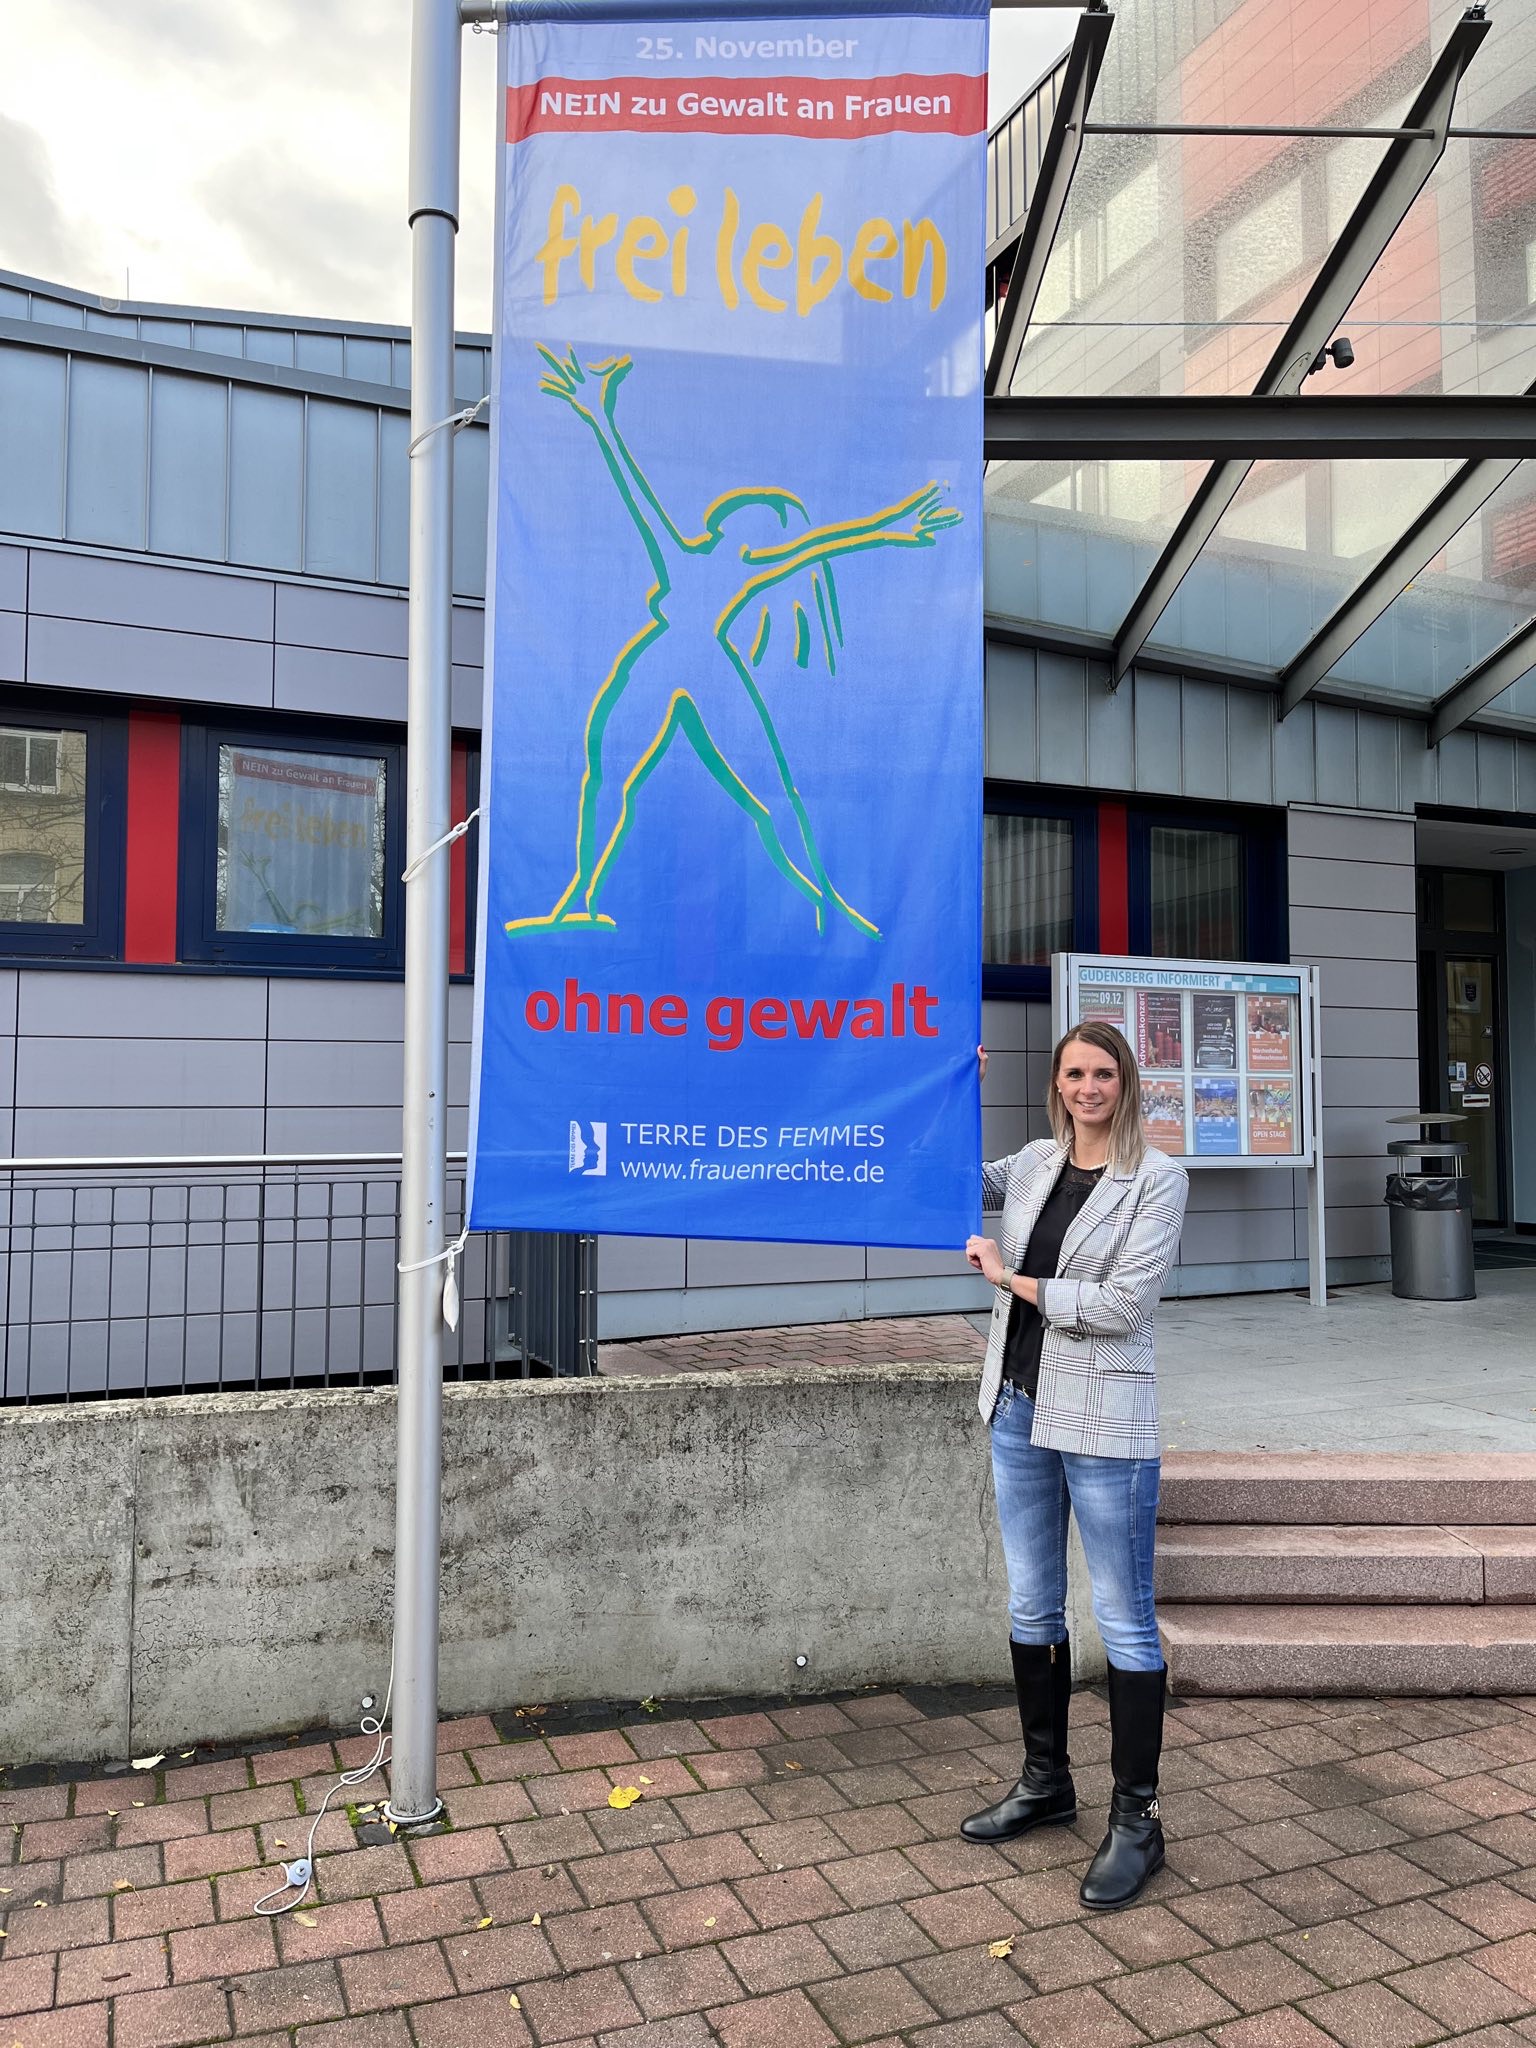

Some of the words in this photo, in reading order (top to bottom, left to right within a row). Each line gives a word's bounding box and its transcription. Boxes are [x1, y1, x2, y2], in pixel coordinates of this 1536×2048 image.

[635, 37, 684, 60] 25.
[695, 34, 859, 60] November
[540, 91, 621, 116] NEIN
[631, 94, 667, 116] zu
[677, 92, 788, 118] Gewalt
[797, 100, 834, 120] an
[845, 90, 951, 121] Frauen
[534, 184, 698, 307] frei
[715, 187, 948, 317] leben
[242, 760, 270, 774] NEIN
[271, 767, 284, 776] zu
[286, 768, 320, 783] Gewalt
[322, 776, 335, 785] an
[337, 777, 368, 790] Frauen
[1079, 968, 1154, 984] GUDENSBERG
[1156, 972, 1221, 987] INFORMIERT
[1100, 991, 1124, 1005] 09.12.
[525, 978, 688, 1037] ohne
[705, 983, 940, 1052] gewalt
[1138, 992, 1146, 1068] Adventskonzert
[621, 1122, 706, 1147] TERRE
[717, 1126, 768, 1148] DES
[778, 1124, 885, 1148] FEMMES
[1253, 1130, 1269, 1138] OPEN
[1269, 1130, 1287, 1138] STAGE
[621, 1158, 885, 1183] www.frauenrechte.de
